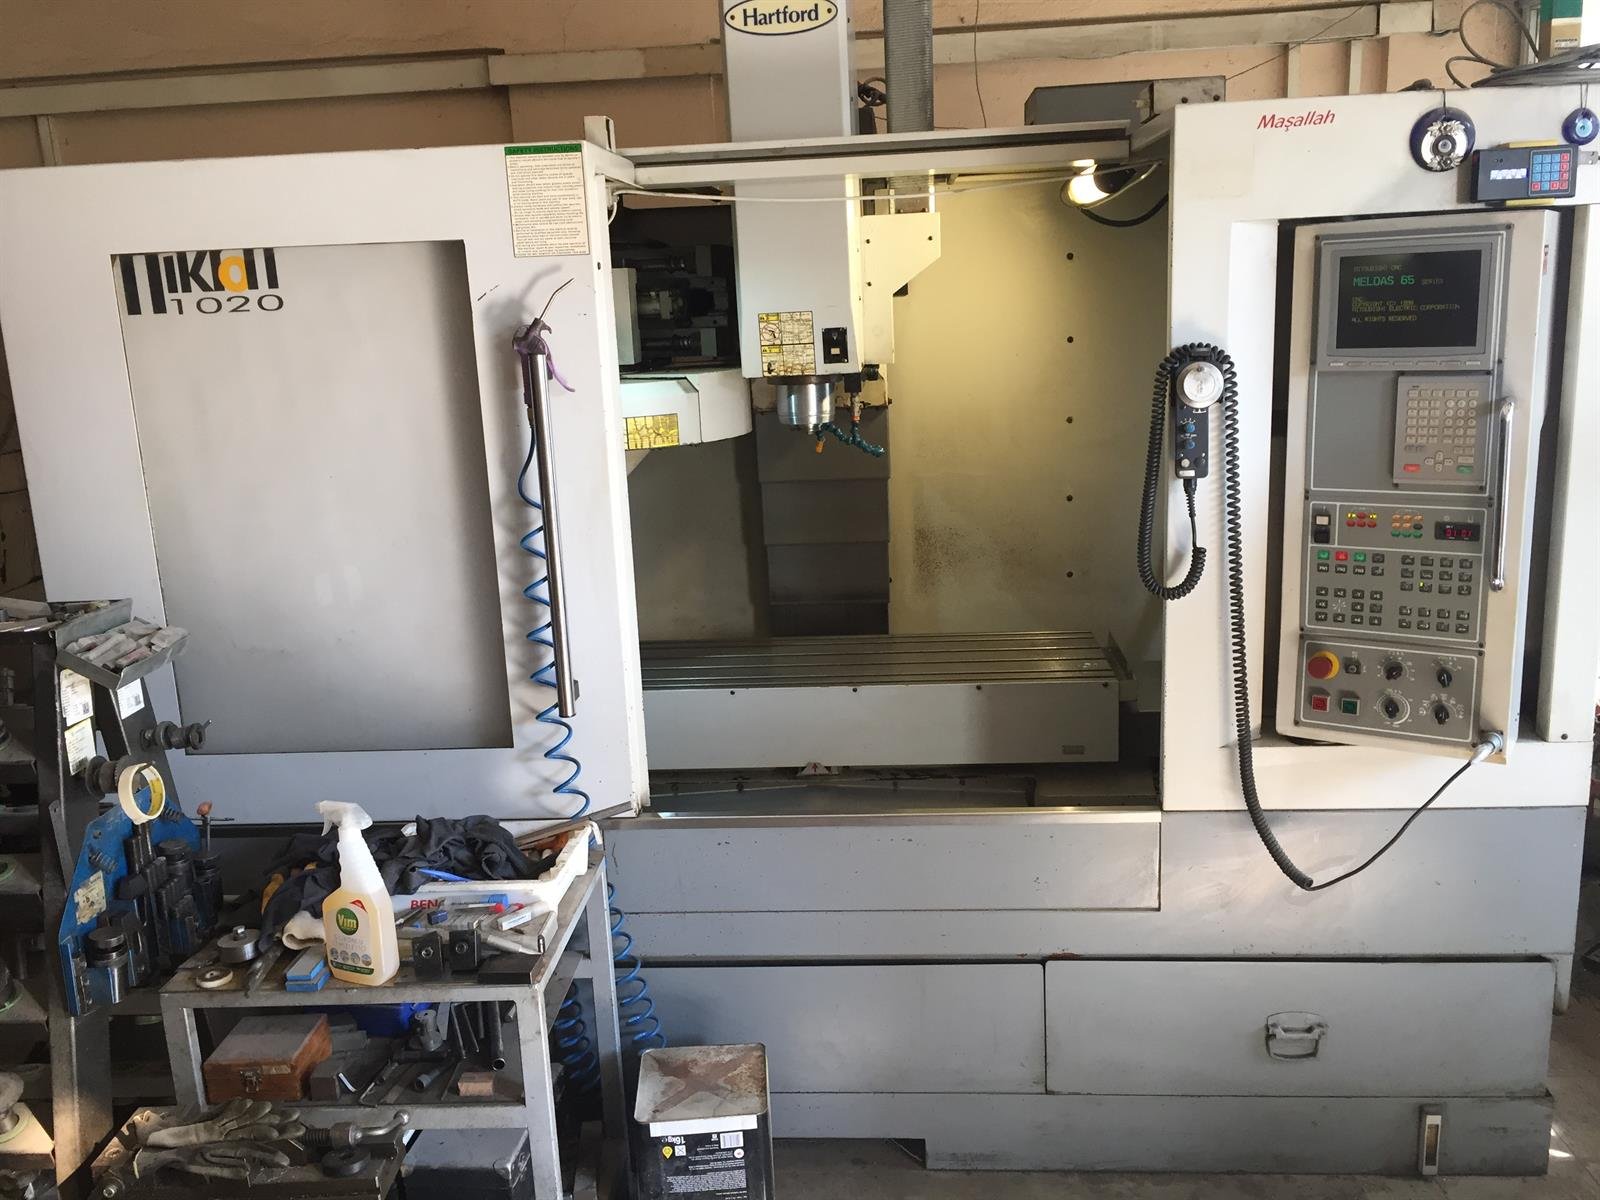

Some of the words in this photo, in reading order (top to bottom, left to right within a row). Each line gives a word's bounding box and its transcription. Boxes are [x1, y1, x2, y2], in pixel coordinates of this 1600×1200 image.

[743, 3, 819, 26] Hartford
[1257, 109, 1336, 132] Maşallah
[1353, 275, 1394, 287] MELDAS
[1400, 274, 1415, 285] 65
[170, 294, 285, 315] 1020
[337, 914, 357, 929] Vim
